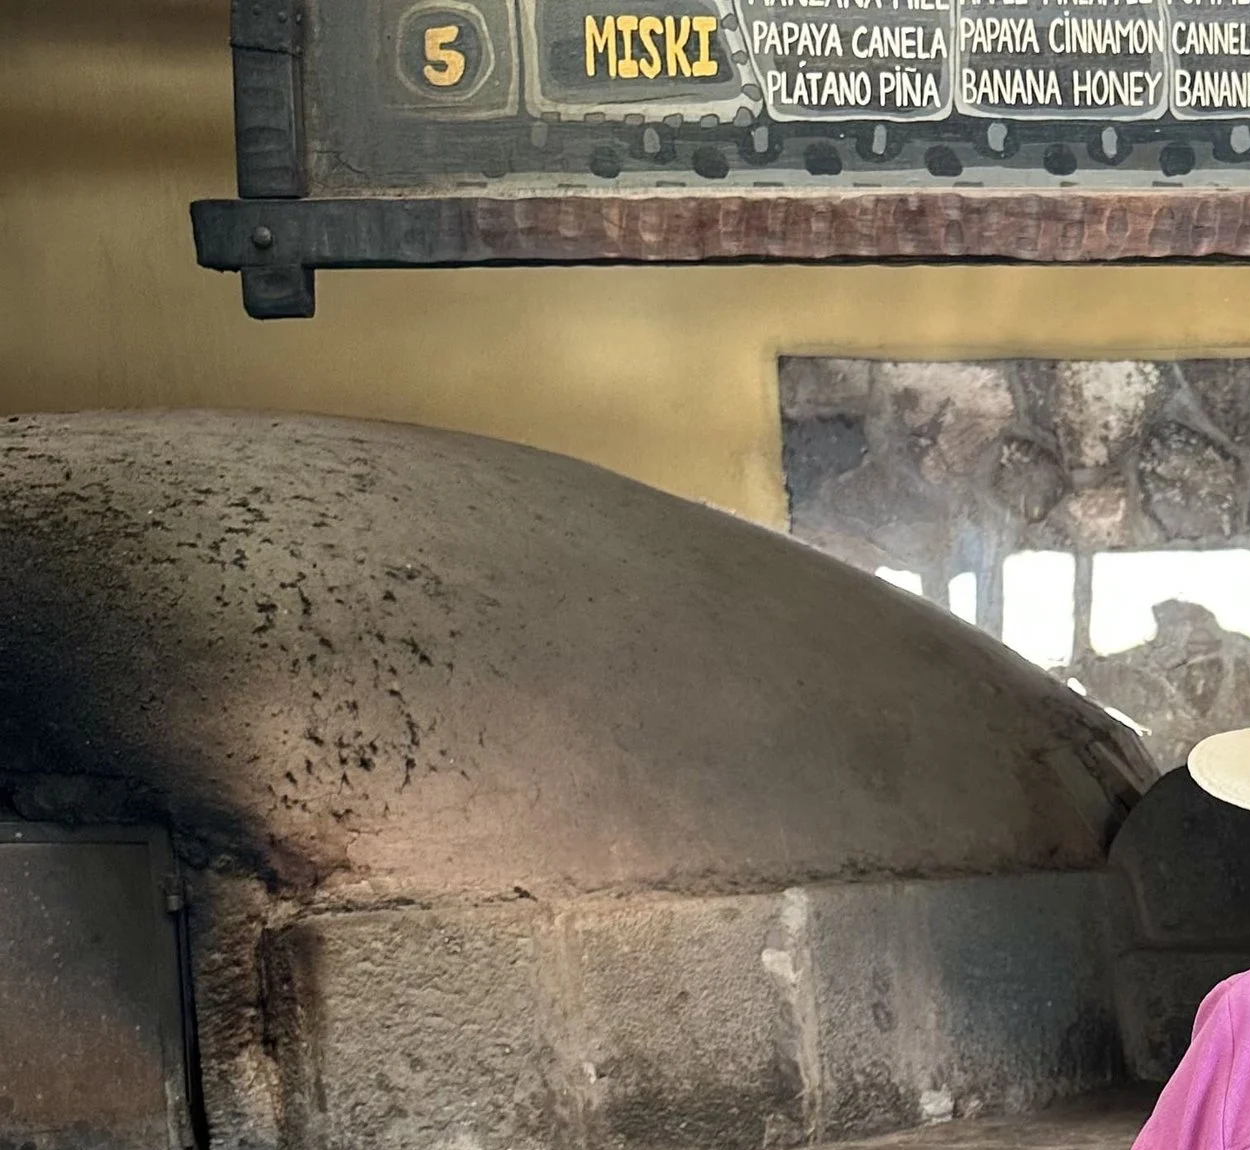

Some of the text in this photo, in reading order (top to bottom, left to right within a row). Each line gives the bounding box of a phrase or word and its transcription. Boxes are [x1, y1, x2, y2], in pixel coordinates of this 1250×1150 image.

[422, 26, 465, 87] 5
[585, 15, 718, 78] MISKI
[753, 20, 948, 59] PAPAYA CANELA
[959, 17, 1040, 53] PAPAYA
[766, 59, 873, 106] PLÁTANO
[962, 69, 1163, 107] BANANA HONEY
